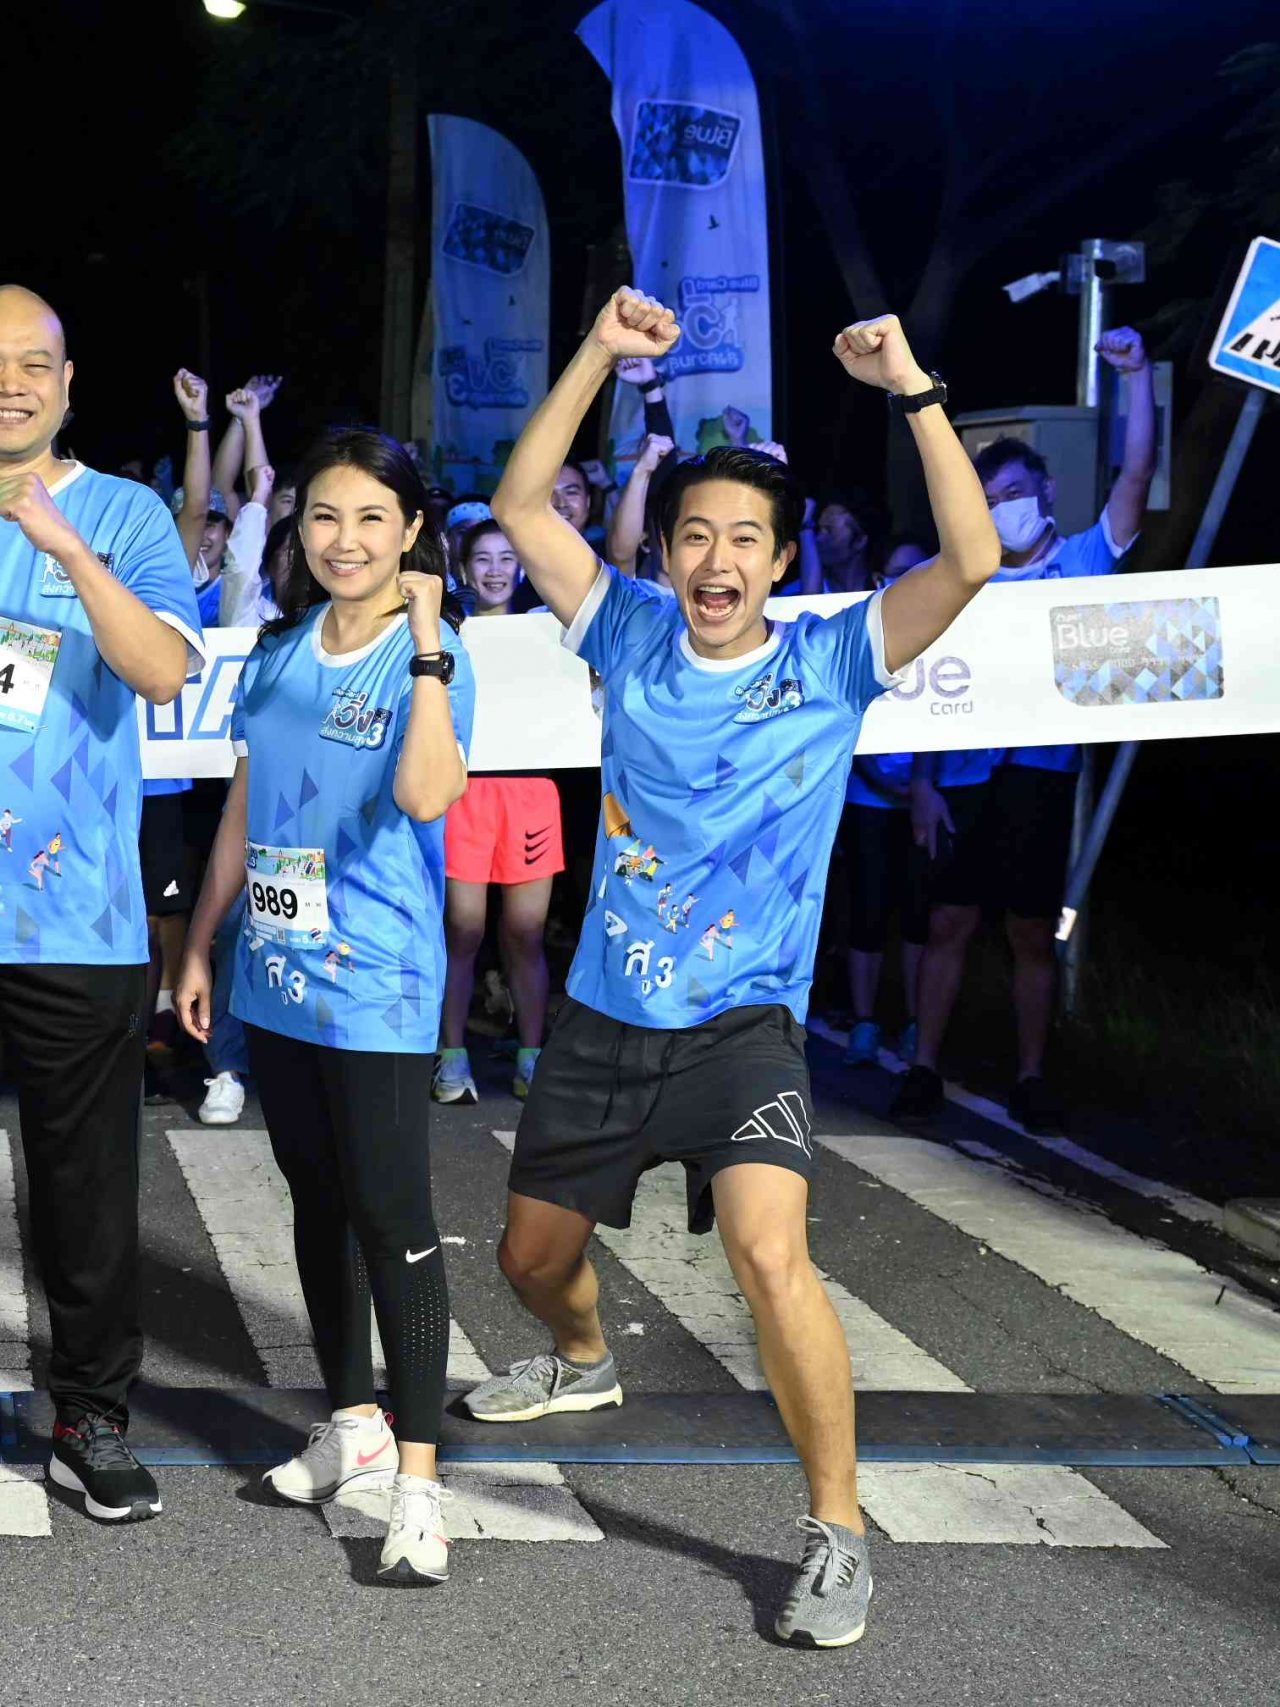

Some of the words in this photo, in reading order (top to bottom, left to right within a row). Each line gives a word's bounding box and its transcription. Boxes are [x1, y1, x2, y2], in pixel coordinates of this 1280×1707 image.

[1057, 622, 1129, 650] Blue
[890, 655, 972, 701] ue
[930, 700, 974, 716] Card
[366, 722, 385, 746] 3
[252, 882, 298, 920] 989
